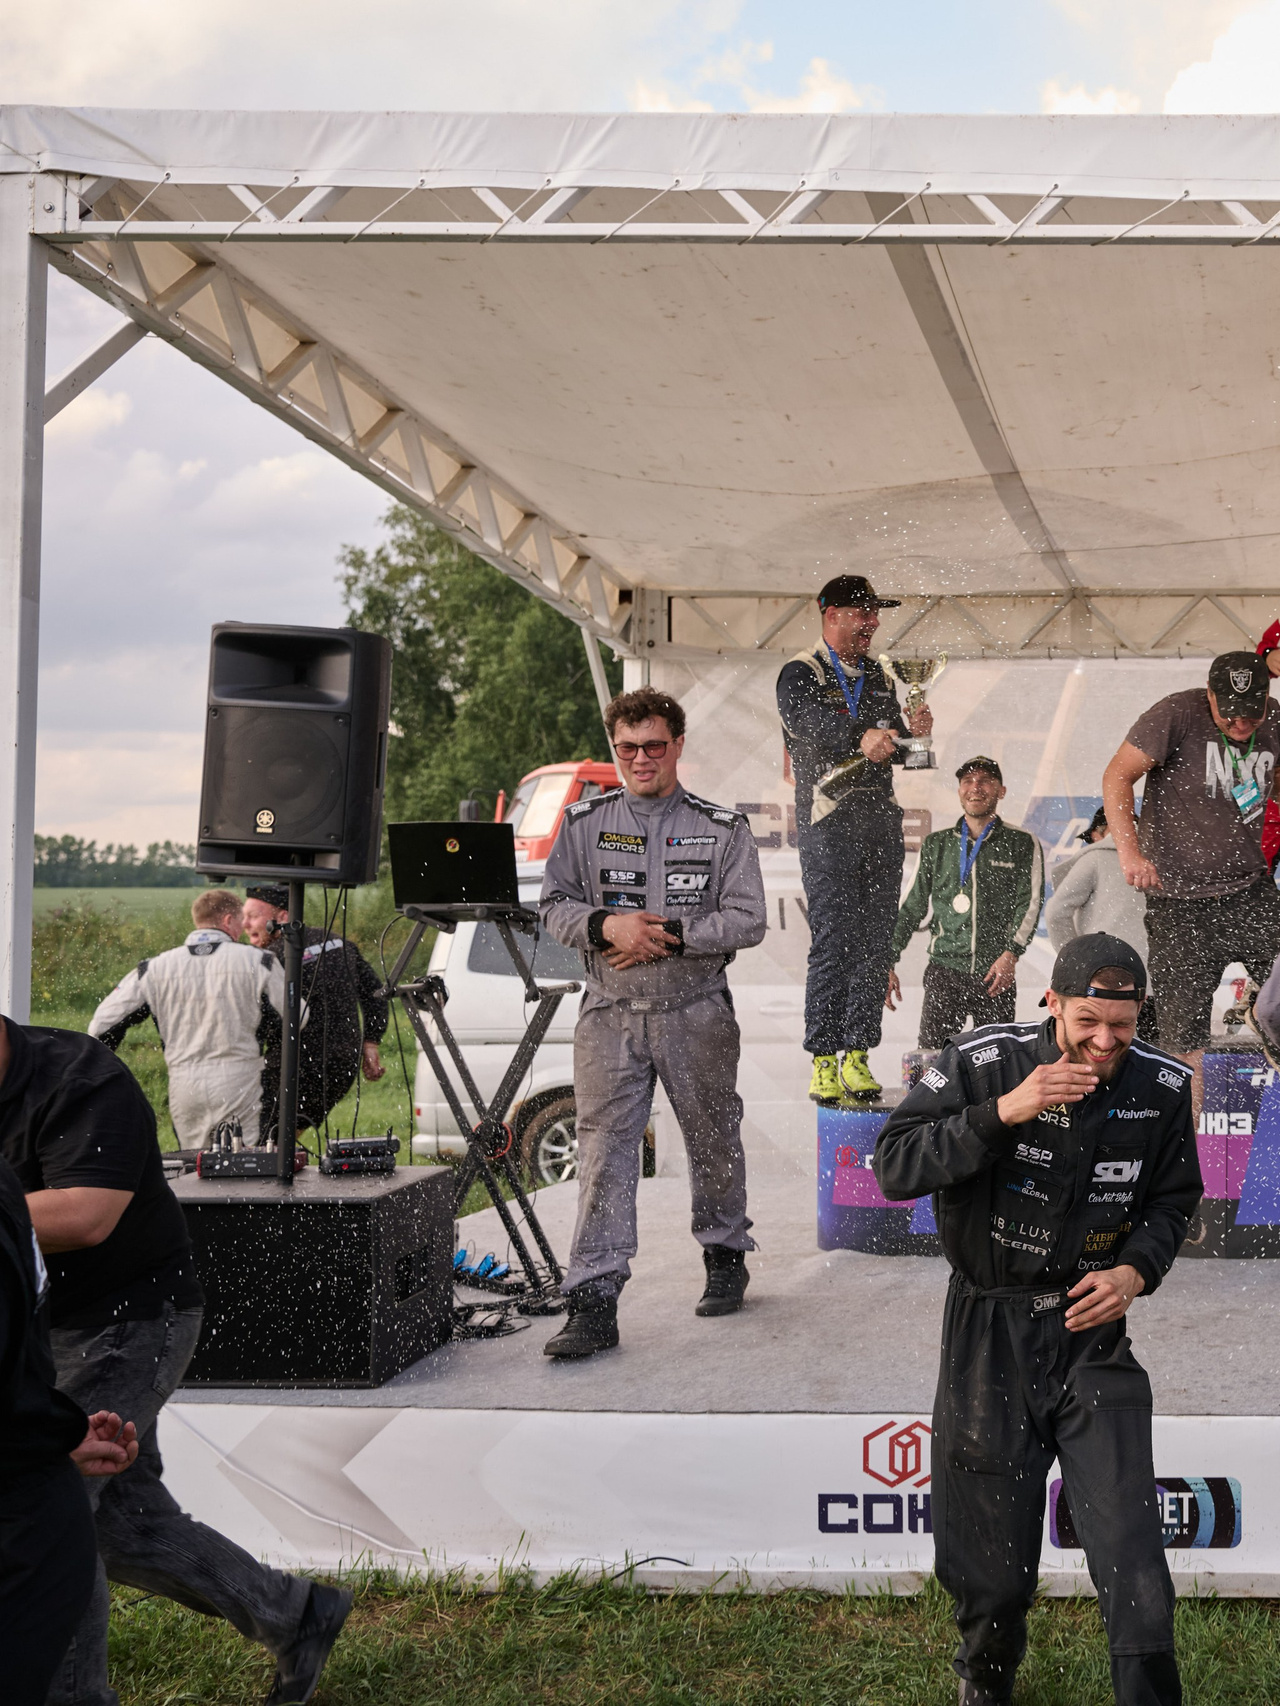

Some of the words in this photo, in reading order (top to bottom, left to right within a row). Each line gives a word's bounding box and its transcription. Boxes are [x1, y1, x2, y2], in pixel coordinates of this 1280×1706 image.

[712, 811, 734, 821] OMP
[598, 840, 645, 854] MOTORS
[603, 833, 643, 845] OMEGA
[680, 836, 716, 845] Valvoline
[609, 870, 636, 880] SSP
[971, 1048, 1000, 1065] OMP
[923, 1070, 946, 1089] OMP
[1158, 1070, 1184, 1088] OMP
[1016, 1143, 1053, 1161] SSP
[1092, 1160, 1143, 1182] SCW
[991, 1213, 1051, 1241] IBALUX
[1033, 1295, 1060, 1310] OMP
[818, 1493, 933, 1533] СОЮ
[1161, 1527, 1188, 1535] RINK
